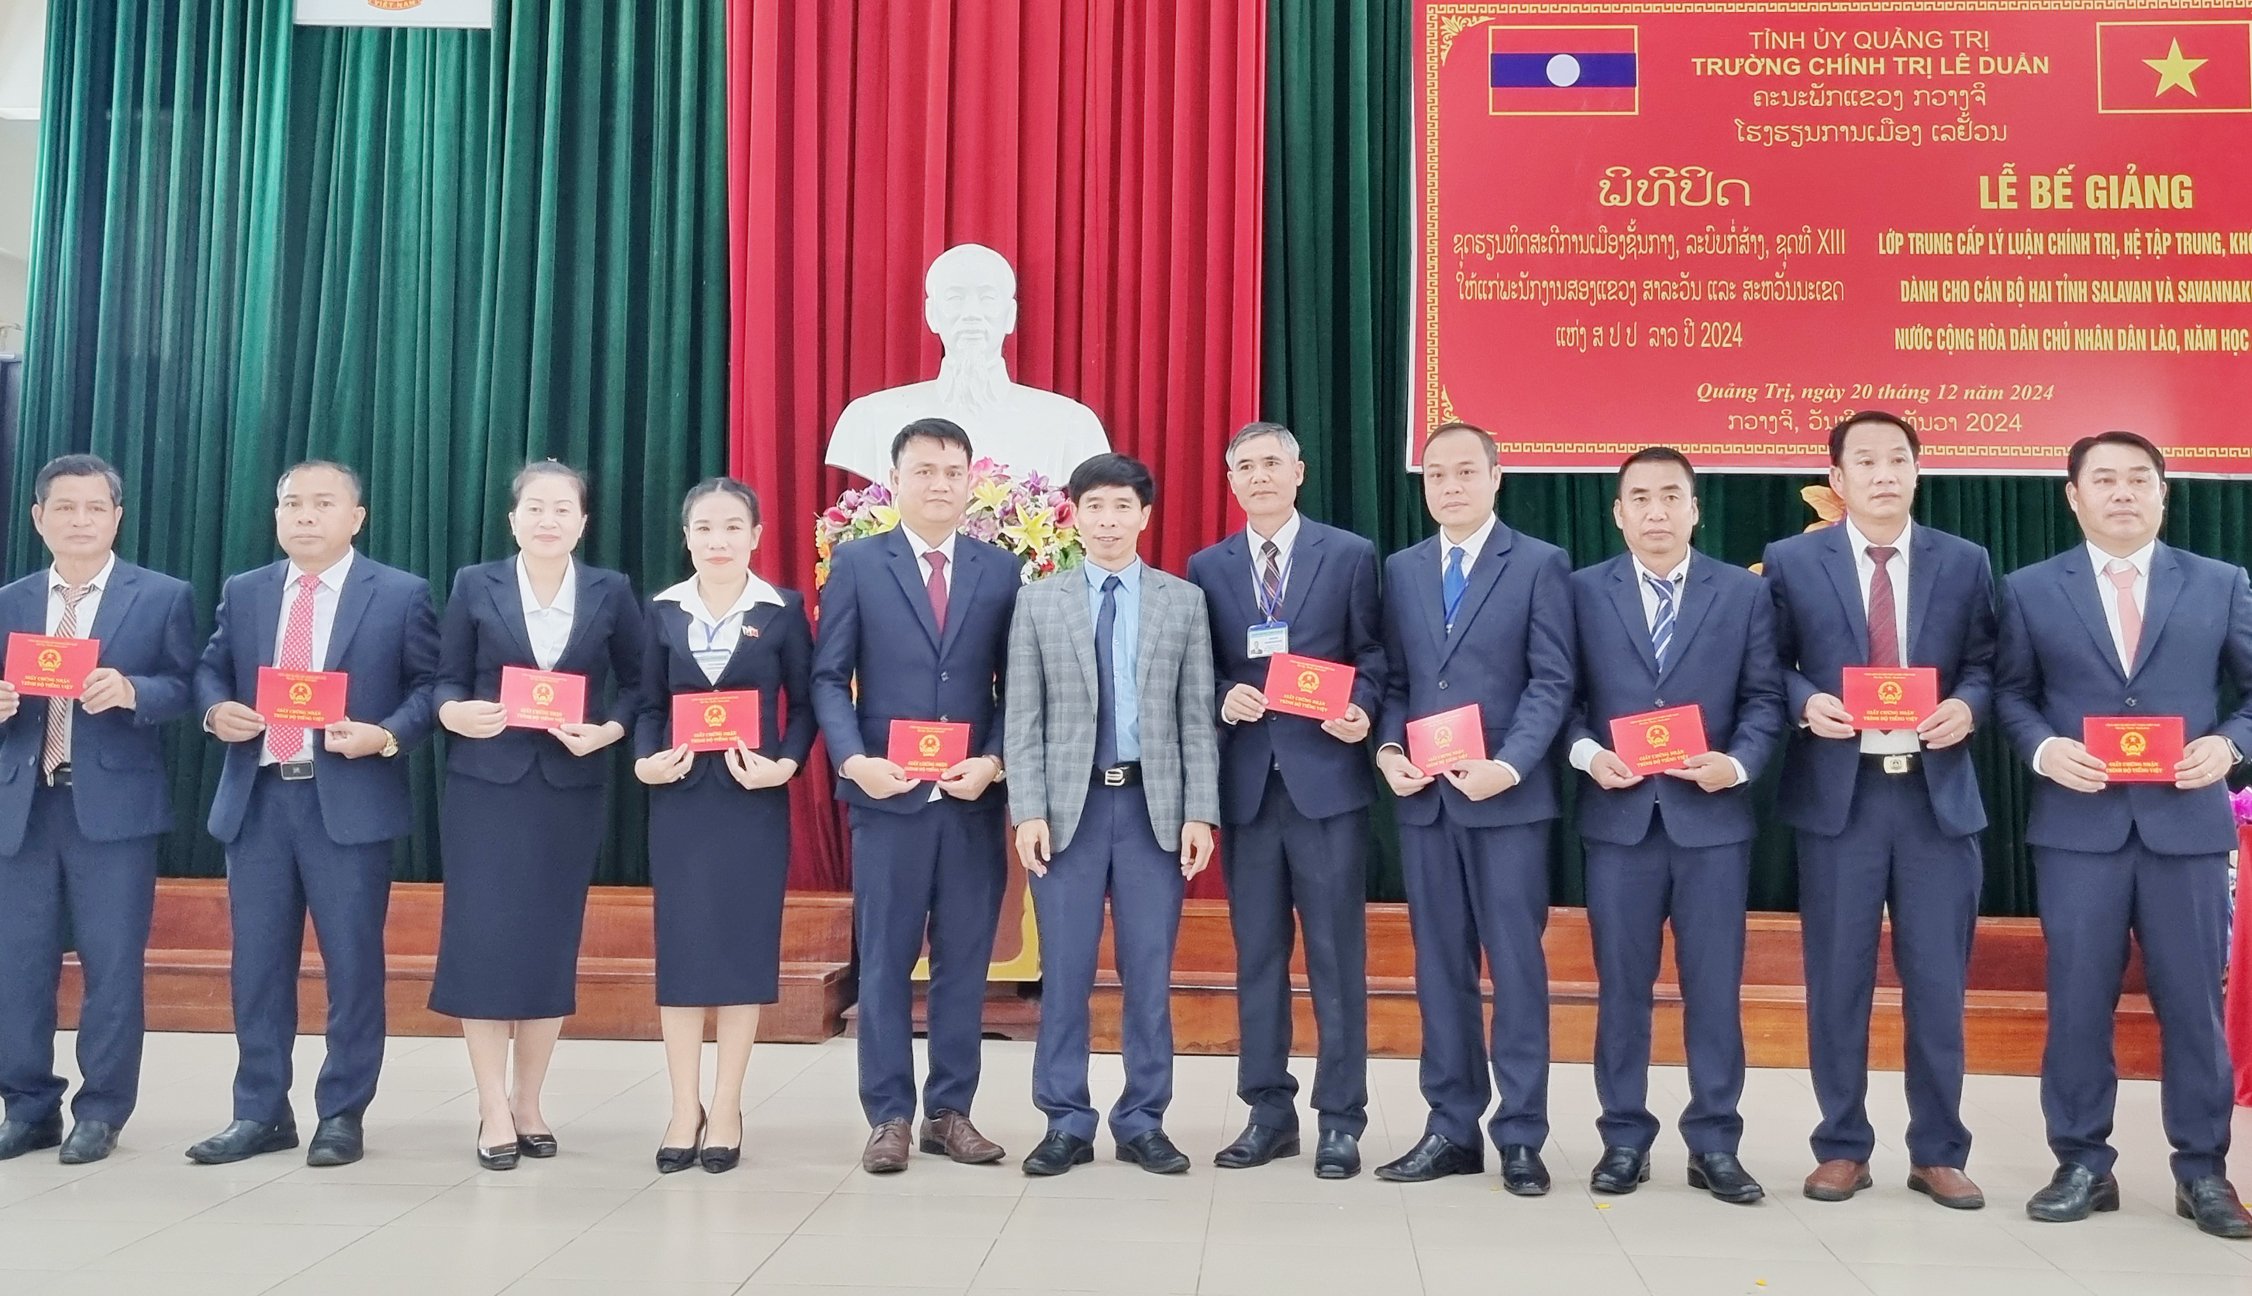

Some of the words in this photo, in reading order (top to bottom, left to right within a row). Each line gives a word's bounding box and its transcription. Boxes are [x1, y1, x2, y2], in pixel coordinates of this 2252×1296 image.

[1748, 27, 1805, 50] TỈNH
[1813, 27, 1847, 50] ỦY
[1853, 26, 1943, 50] QUẢNG
[1949, 30, 1989, 52] TRỊ
[1690, 53, 1801, 76] TRƯỜNG
[1808, 52, 1885, 76] CHÍNH
[1892, 56, 1932, 80] TRỊ
[1940, 52, 1971, 75] LÊ
[1753, 82, 1904, 112] ຄະນະພັກແຂວງ
[1913, 81, 1986, 112] ກວາງຈິ
[1733, 117, 1922, 148] ໂຮງຮຽນການເມືອງ
[1598, 165, 1751, 207] ພິທີປິດ
[1979, 162, 2019, 210] LỄ
[2029, 163, 2076, 209] BẾ
[2085, 162, 2193, 210] GIẢNG
[1775, 224, 1812, 270] ຊຸດທີ
[1816, 228, 1846, 255] XIII
[1878, 227, 1905, 255] LỚP
[1907, 232, 1954, 255] TRUNG
[1956, 224, 1985, 255] CẤP
[1988, 227, 2005, 255] LÝ
[2007, 227, 2044, 260] LUẬN
[2047, 227, 2091, 255] CHÍNH
[2093, 232, 2121, 260] TRỊ,
[2123, 227, 2142, 260] HỆ
[2144, 227, 2173, 260] TẬP
[2174, 231, 2227, 258] TRUNG,
[1642, 271, 1702, 301] ສາລະວັນ
[1707, 280, 1737, 301] ແລະ
[1742, 271, 1844, 301] ສະຫວັນນະເຂດ
[1900, 275, 1939, 303] DÀNH
[1942, 279, 1970, 303] CHO
[1973, 275, 2003, 303] CÁN
[2006, 275, 2025, 308] BỘ
[2028, 280, 2053, 303] HAI
[2055, 272, 2088, 303] TỈNH
[2091, 280, 2153, 303] SALAVAN
[2155, 275, 2175, 303] VÀ
[2177, 280, 2252, 303] SAVANNAK
[1555, 319, 1587, 353] ແຫ່ງ
[1592, 326, 1604, 347] ສ
[1609, 321, 1621, 347] ປ
[1626, 321, 1637, 348] ປ
[1648, 326, 1678, 348] ລາວ
[1683, 317, 1695, 348] ປີ
[1700, 321, 1743, 348] 2024
[1894, 323, 1933, 351] NƯỚC
[1936, 323, 1975, 356] CỘNG
[1978, 322, 2007, 351] HÒA
[2009, 323, 2039, 351] DÂN
[2042, 320, 2071, 351] CHỦ
[2074, 323, 2114, 351] NHÂN
[2117, 323, 2147, 351] DÂN
[2150, 323, 2181, 354] LÀO,
[2183, 323, 2218, 352] NĂM
[2220, 328, 2250, 357] HỌC
[1696, 382, 1759, 403] Quảng
[1765, 383, 1795, 403] Trị,
[1801, 383, 1846, 404] ngày
[1850, 383, 1873, 400] 20
[1877, 383, 1931, 404] tháng
[1937, 384, 1958, 400] 12
[1963, 385, 2004, 400] năm
[2009, 384, 2055, 401] 2024
[1966, 412, 2023, 432] 2024
